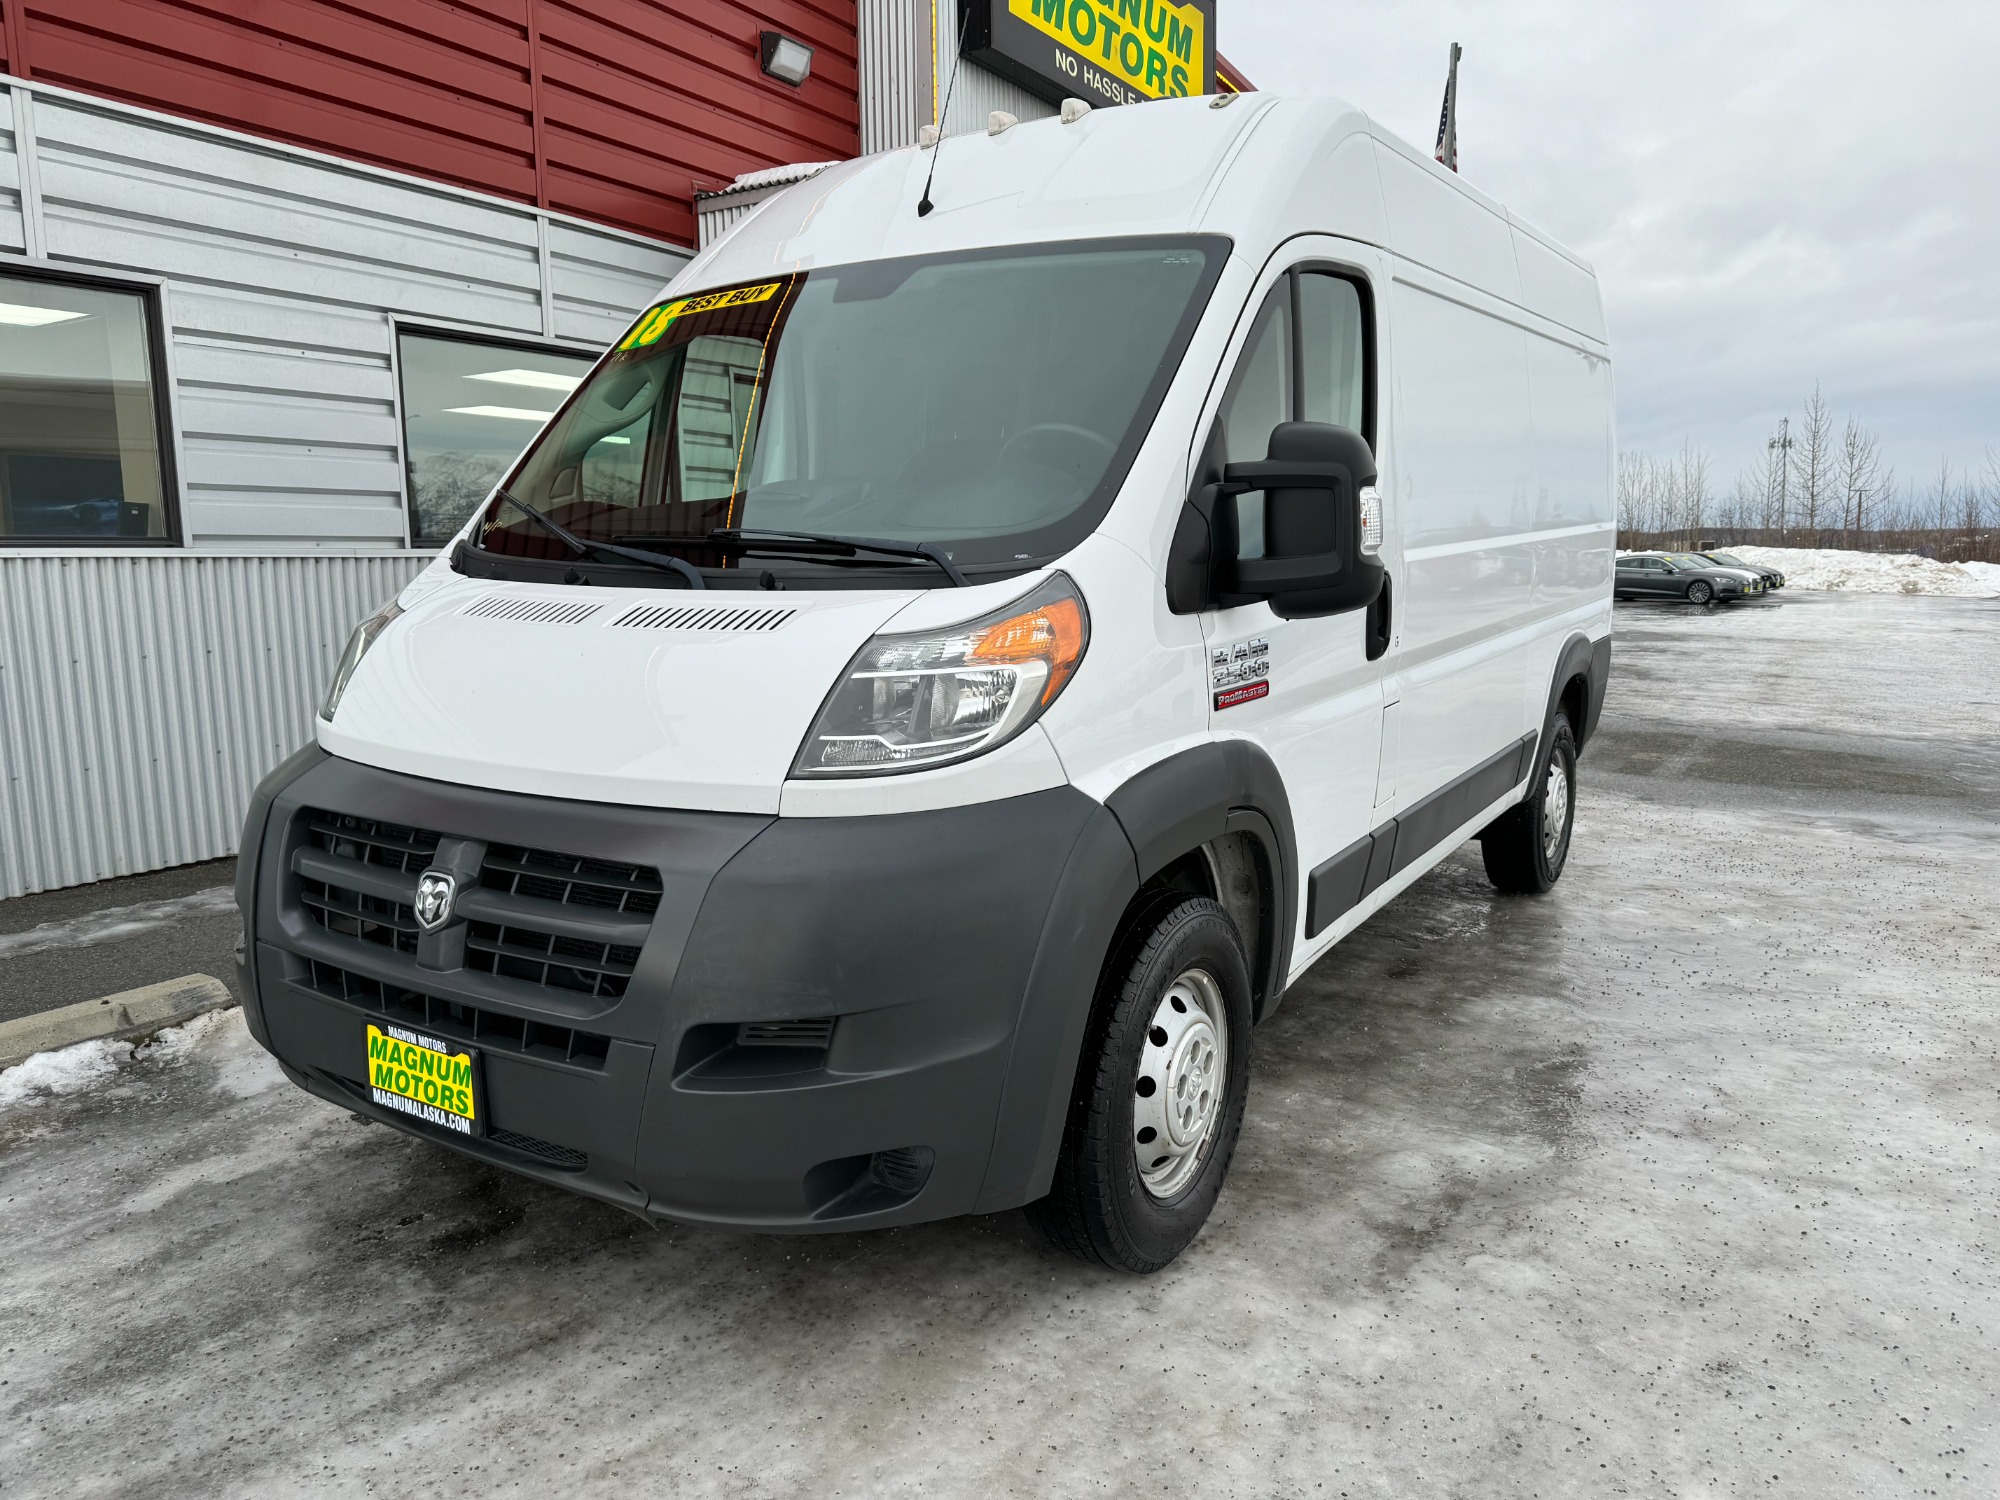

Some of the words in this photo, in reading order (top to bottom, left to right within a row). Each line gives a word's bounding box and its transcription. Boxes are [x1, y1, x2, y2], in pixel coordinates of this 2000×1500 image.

[1031, 0, 1188, 97] MOTORS
[1055, 48, 1078, 77] NO
[1083, 65, 1136, 106] HASSLE
[680, 292, 729, 315] BEST
[724, 285, 774, 305] BUY
[1211, 637, 1269, 668] RAM
[370, 1035, 471, 1089] MAGNUM
[388, 1025, 417, 1045] MAGNUM
[418, 1034, 447, 1054] MOTORS
[373, 1087, 471, 1135] MAGNUMALASKA.COM
[375, 1063, 469, 1115] MOTORS
